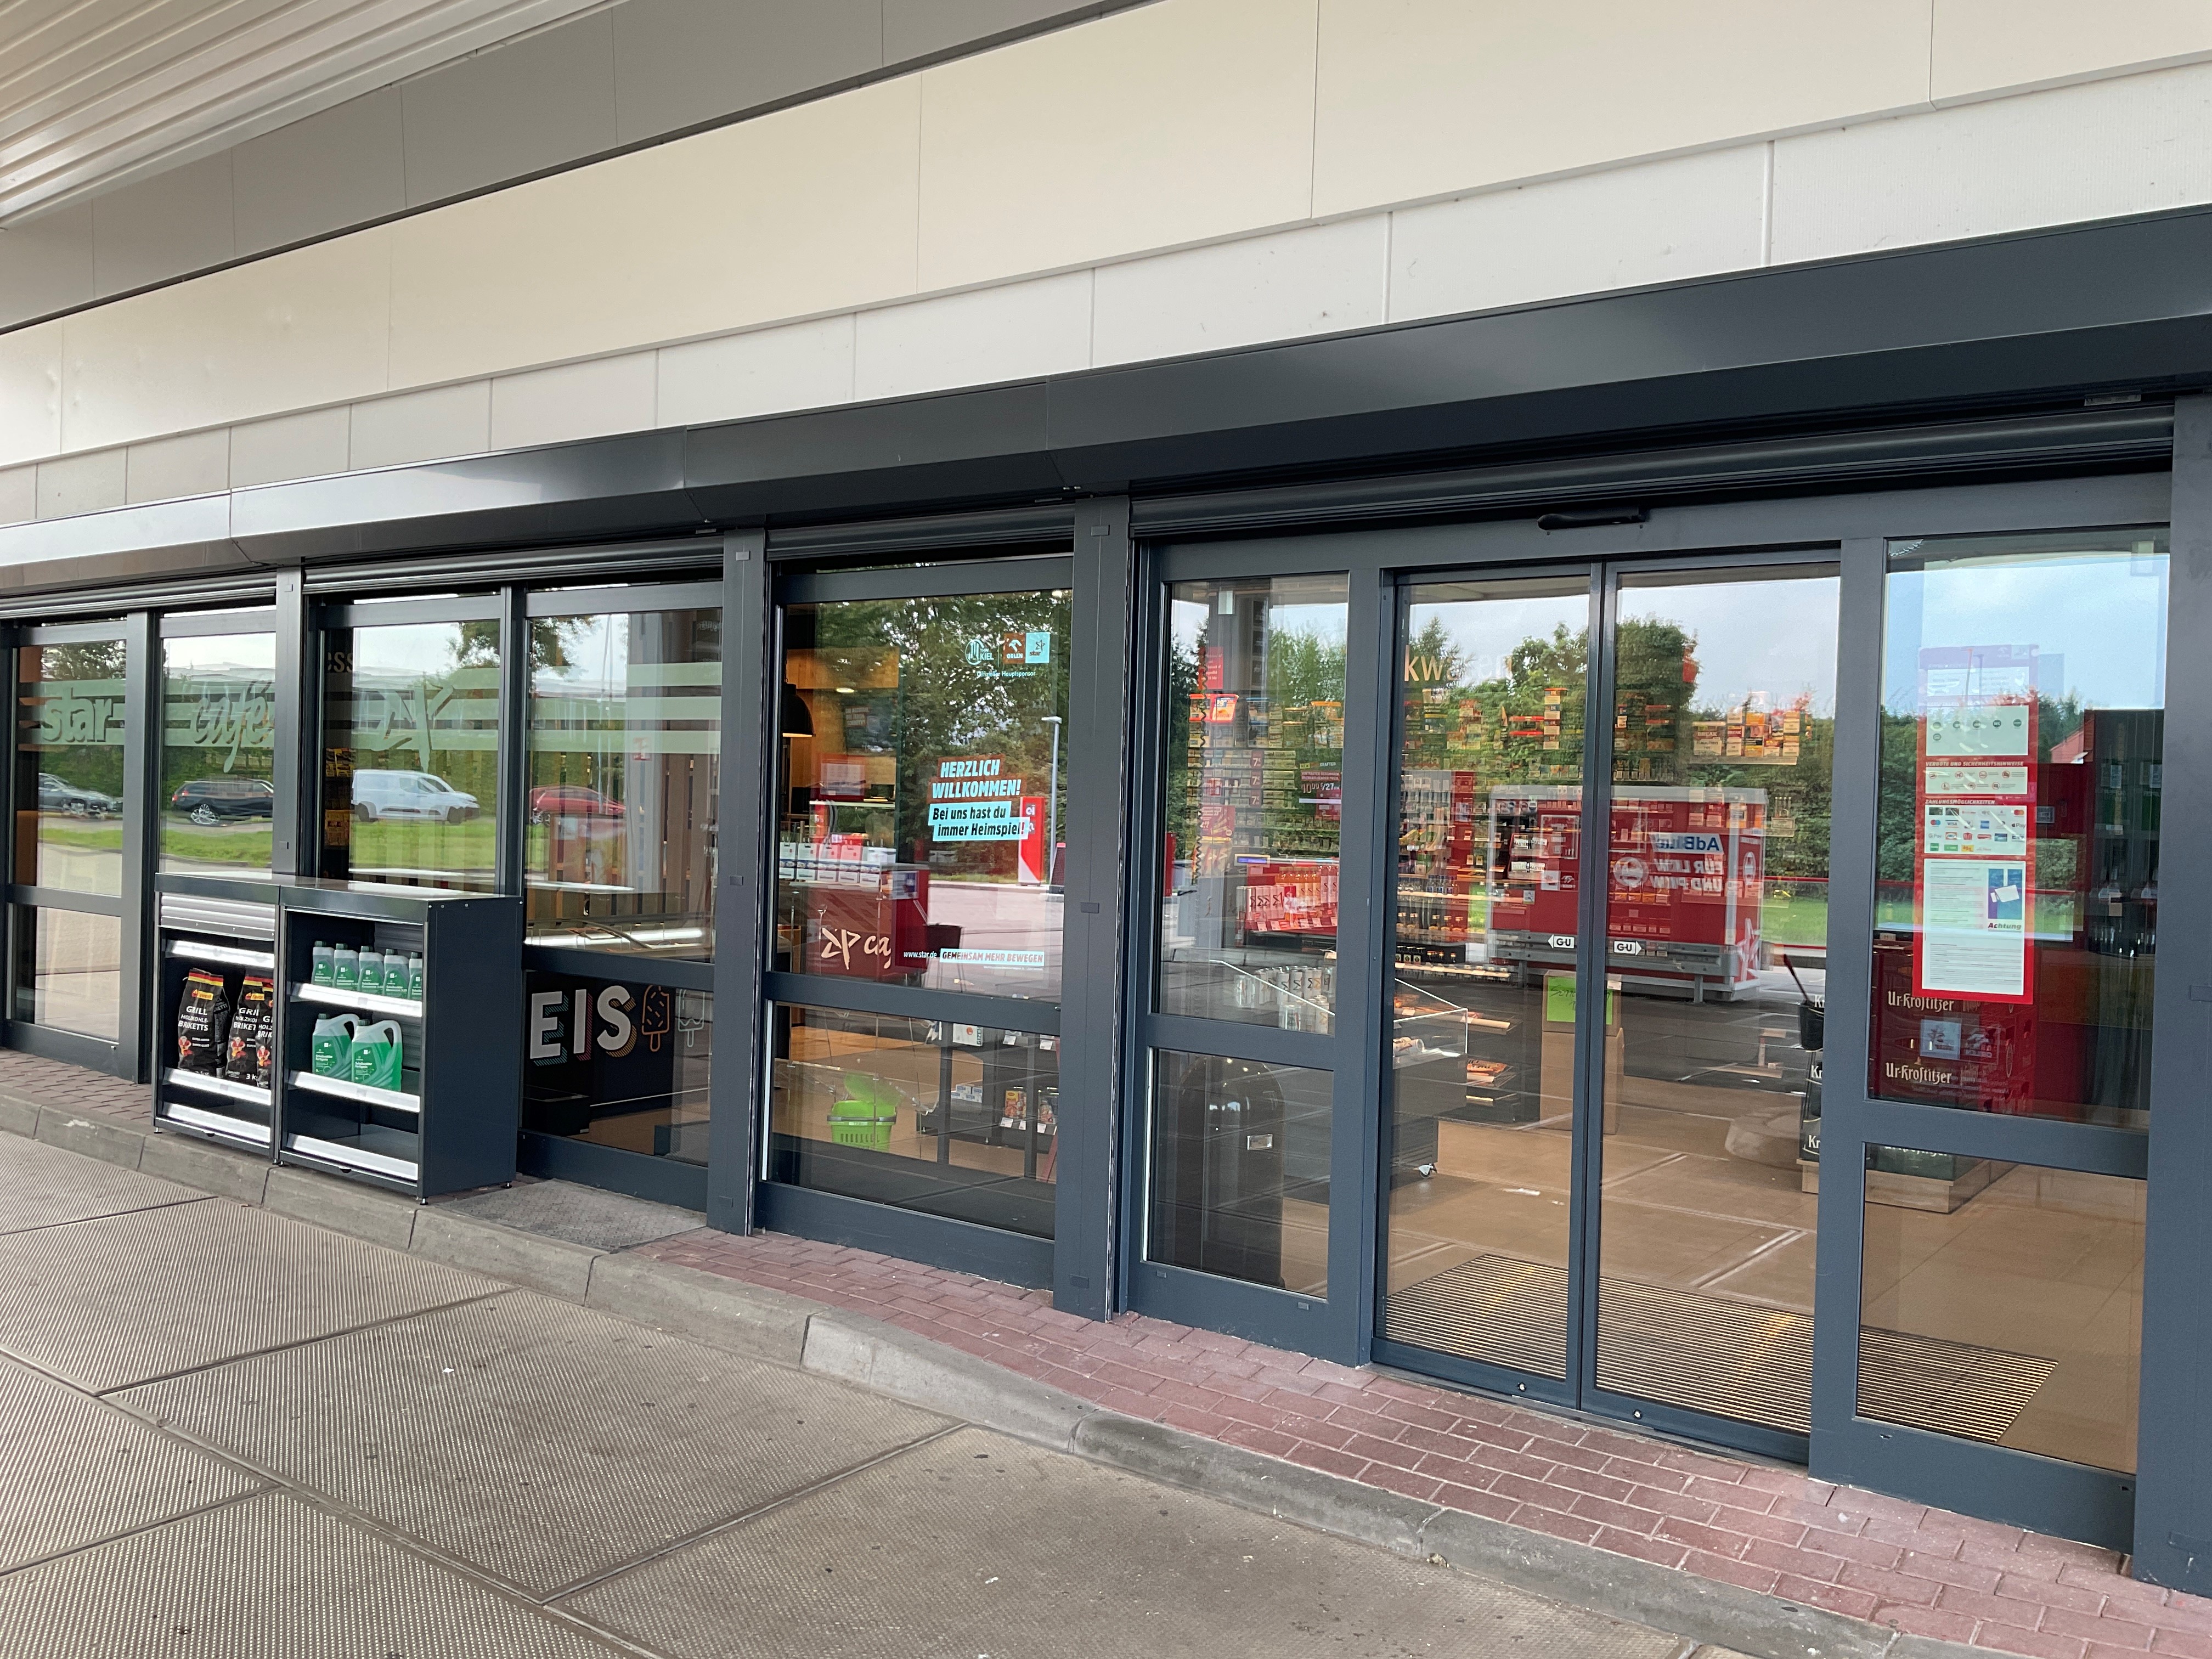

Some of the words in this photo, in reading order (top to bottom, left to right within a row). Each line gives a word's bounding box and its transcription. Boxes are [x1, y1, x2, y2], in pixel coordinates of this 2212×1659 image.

[41, 687, 113, 743] star
[192, 681, 273, 773] café
[940, 759, 1001, 778] HERZLICH
[932, 779, 1022, 799] WILLKOMMEN!
[933, 808, 949, 820] Bei
[951, 809, 968, 820] uns
[970, 807, 991, 819] hast
[994, 806, 1007, 818] du
[938, 824, 969, 836] immer
[971, 822, 1025, 837] Heimspiel!
[1988, 922, 2022, 930] Achtung
[942, 951, 983, 961] GEMEINSAM
[985, 952, 1006, 962] MEHR
[1007, 953, 1043, 963] BEWEGEN
[186, 1006, 208, 1015] GRILL
[178, 1020, 208, 1031] BRIKETTS
[530, 985, 636, 1066] EIS
